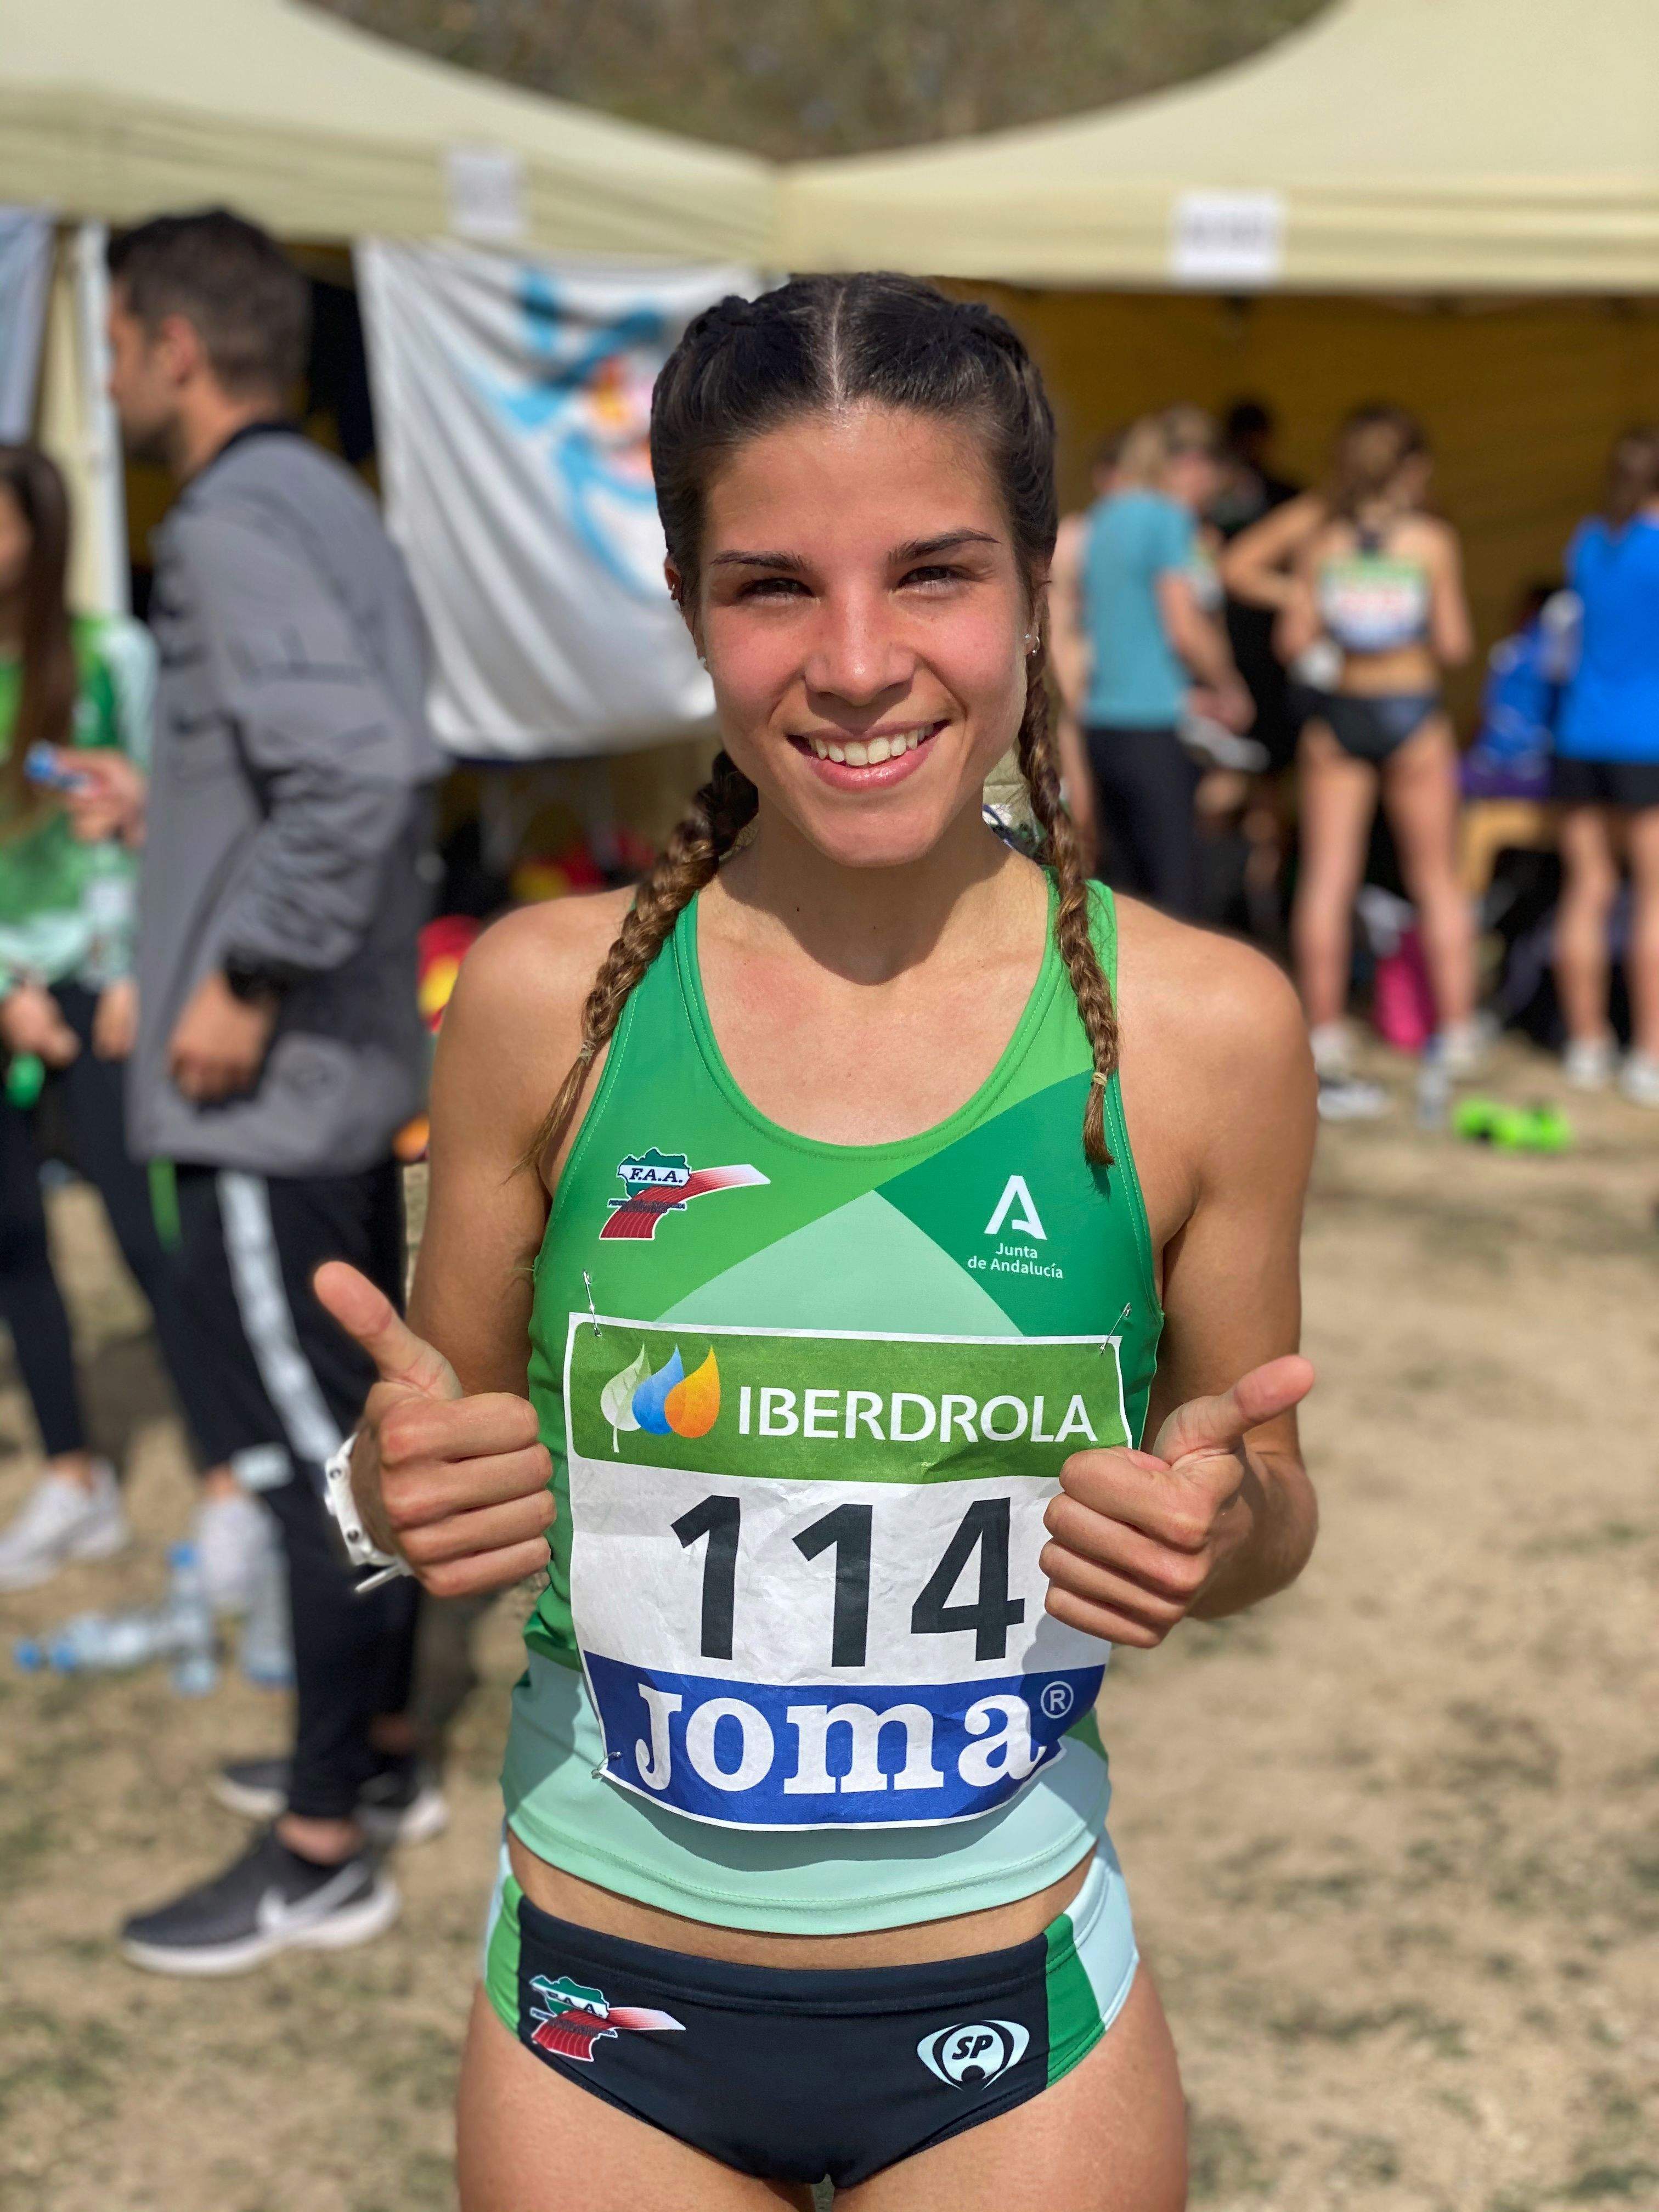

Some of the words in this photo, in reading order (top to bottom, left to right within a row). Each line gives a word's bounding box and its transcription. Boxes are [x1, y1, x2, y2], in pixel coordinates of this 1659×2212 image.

[629, 1168, 683, 1183] F.A.A.
[995, 1242, 1038, 1259] Junta
[967, 1255, 987, 1269] de
[990, 1257, 1063, 1279] Andalucía
[738, 1386, 1098, 1443] IBERDROLA
[671, 1494, 1025, 1667] 114
[951, 2034, 994, 2059] SP
